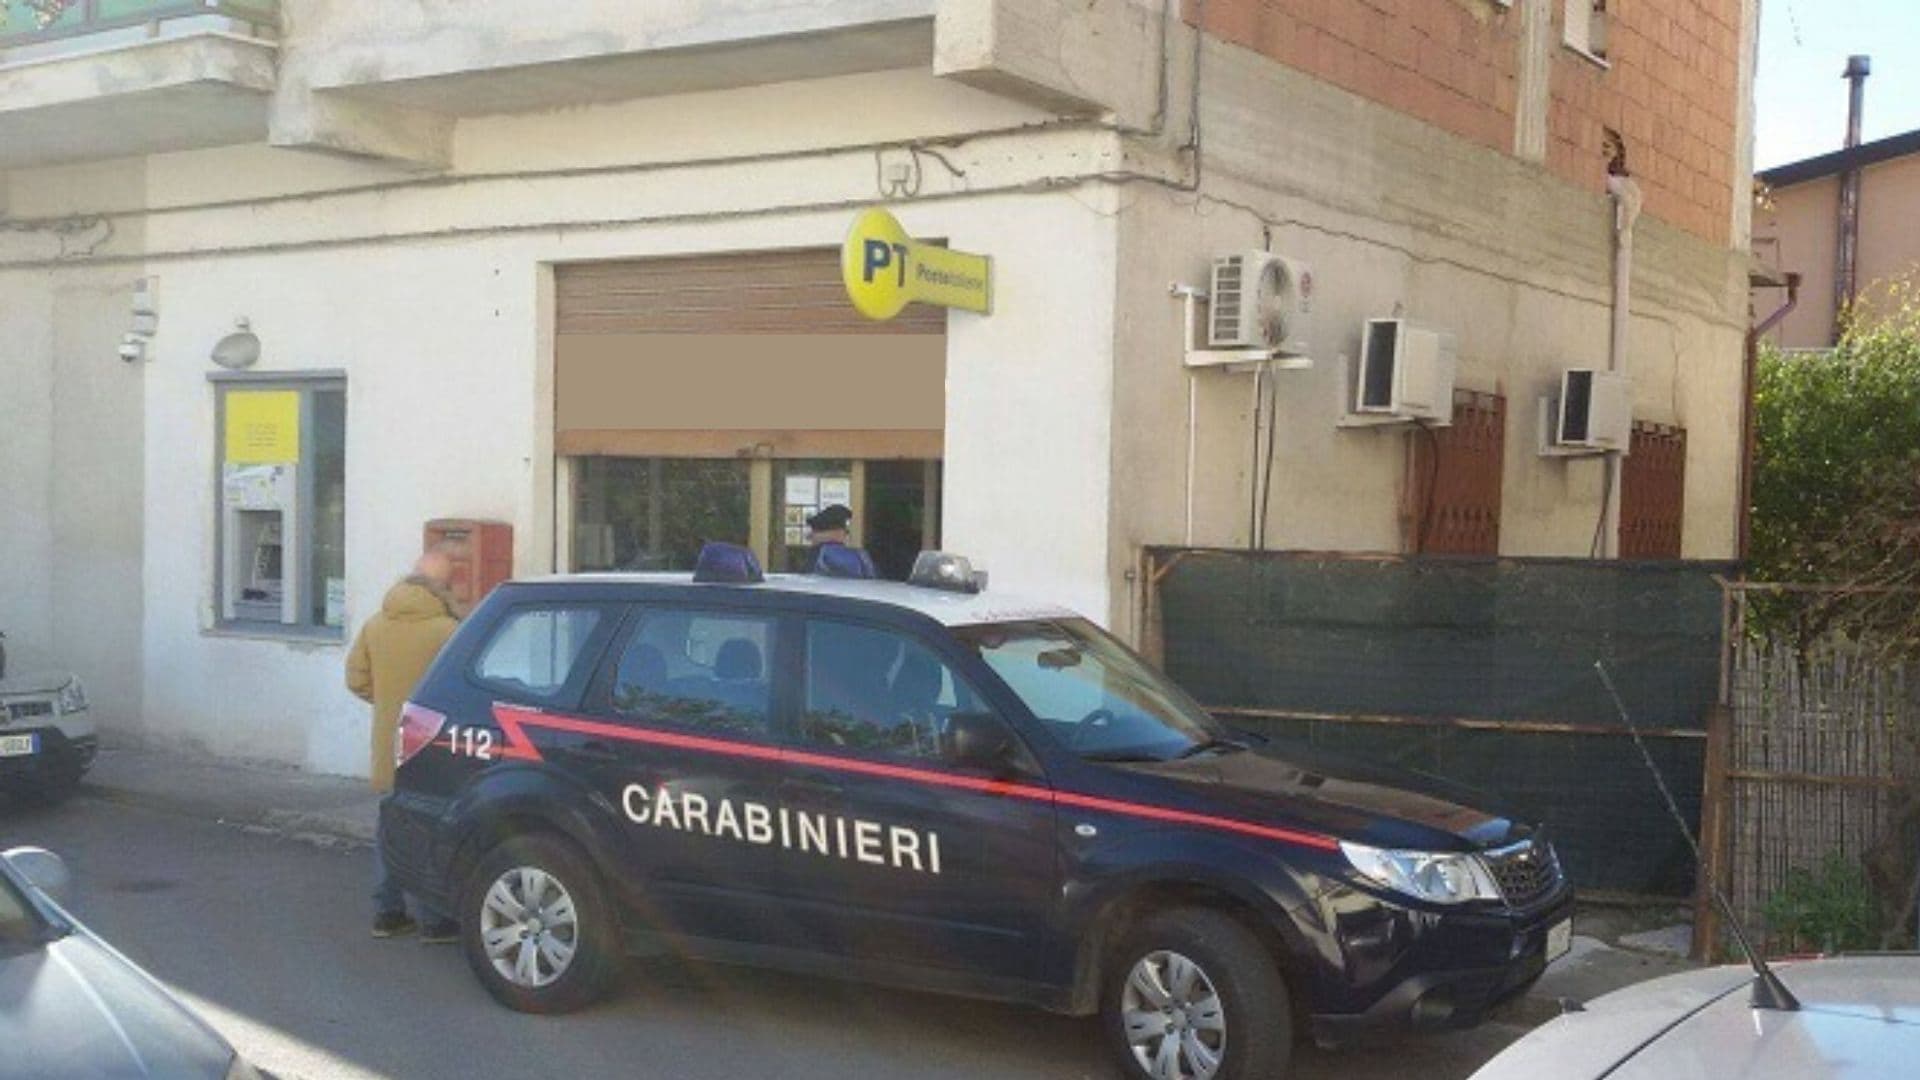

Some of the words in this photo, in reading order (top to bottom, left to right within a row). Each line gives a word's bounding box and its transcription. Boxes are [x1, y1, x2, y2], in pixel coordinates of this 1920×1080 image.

[863, 239, 907, 287] PT
[447, 725, 492, 760] 112
[622, 784, 941, 874] CARABINIERI
